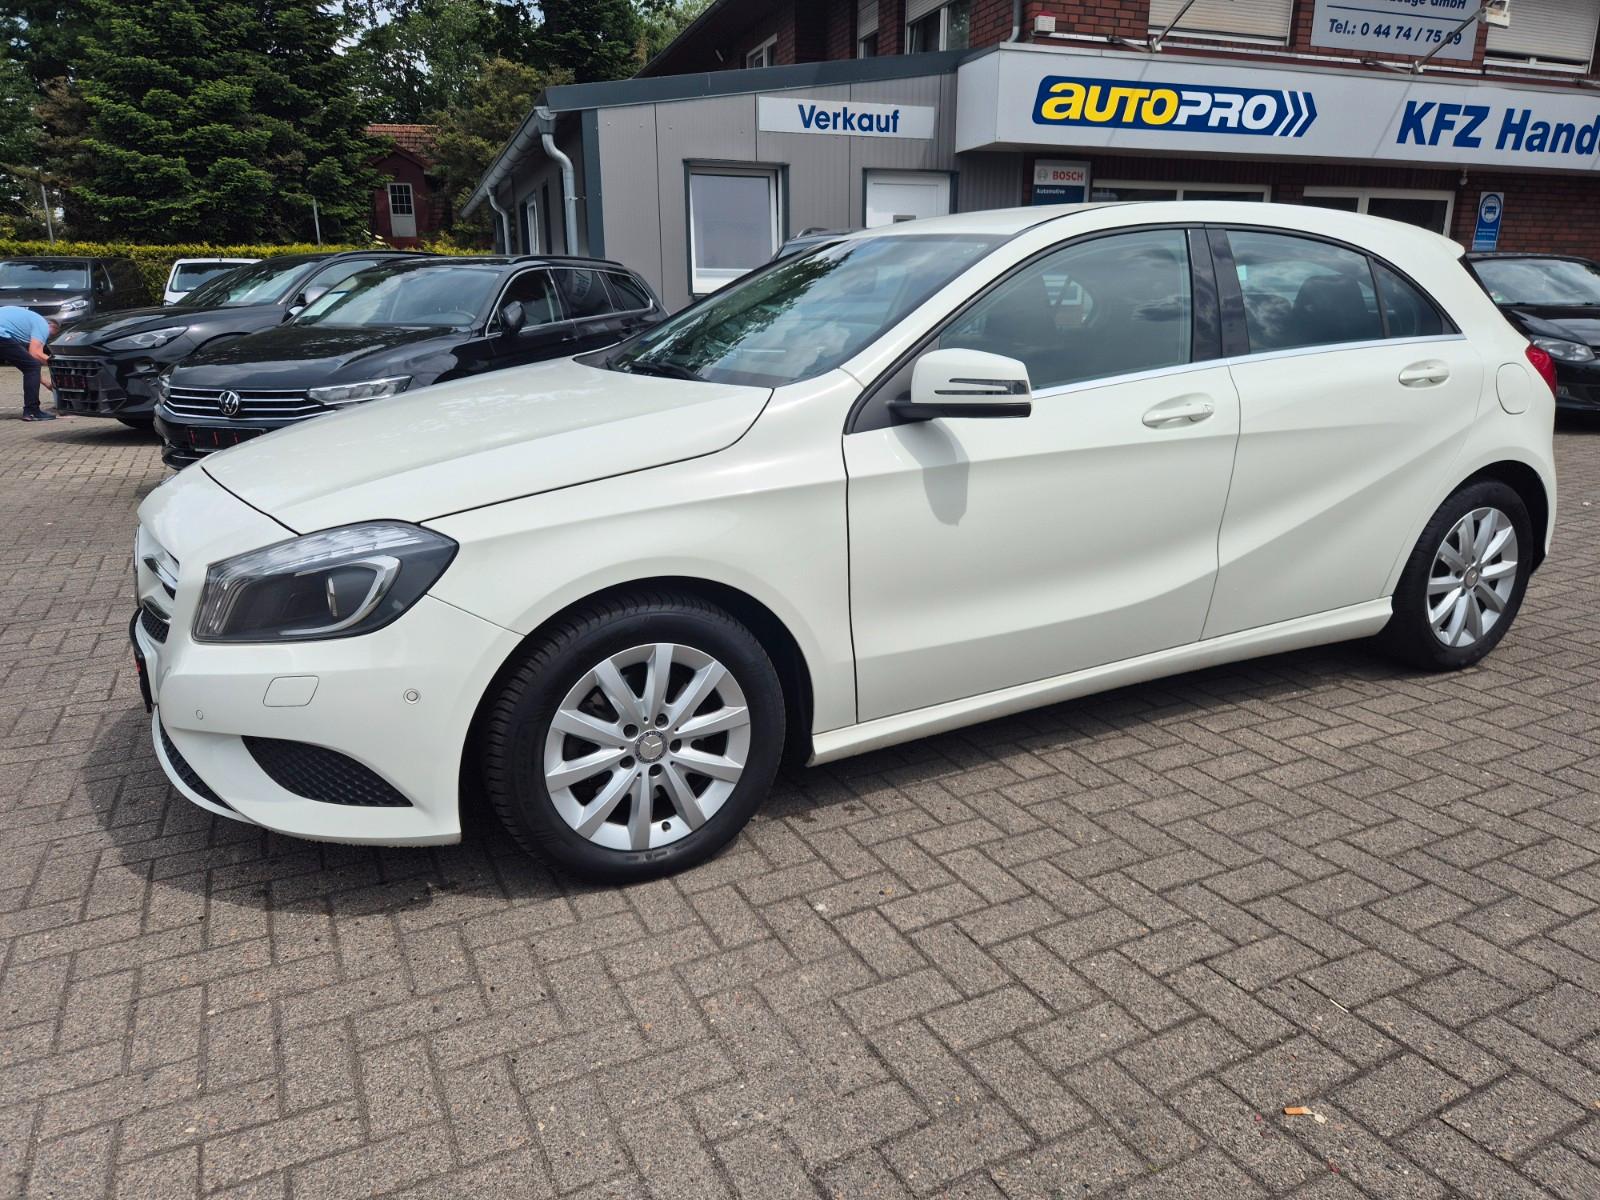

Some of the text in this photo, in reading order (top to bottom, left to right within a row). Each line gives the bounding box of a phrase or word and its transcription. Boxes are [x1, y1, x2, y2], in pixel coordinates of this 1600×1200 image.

[1328, 18, 1357, 35] Tel.:
[1360, 22, 1370, 36] 0
[1373, 24, 1391, 38] 44
[1395, 25, 1412, 41] 74
[1414, 28, 1423, 41] /
[1426, 29, 1443, 43] 75
[798, 104, 900, 133] Verkauf
[1396, 100, 1600, 155] KFZ Hand
[1052, 170, 1084, 181] BOSCH
